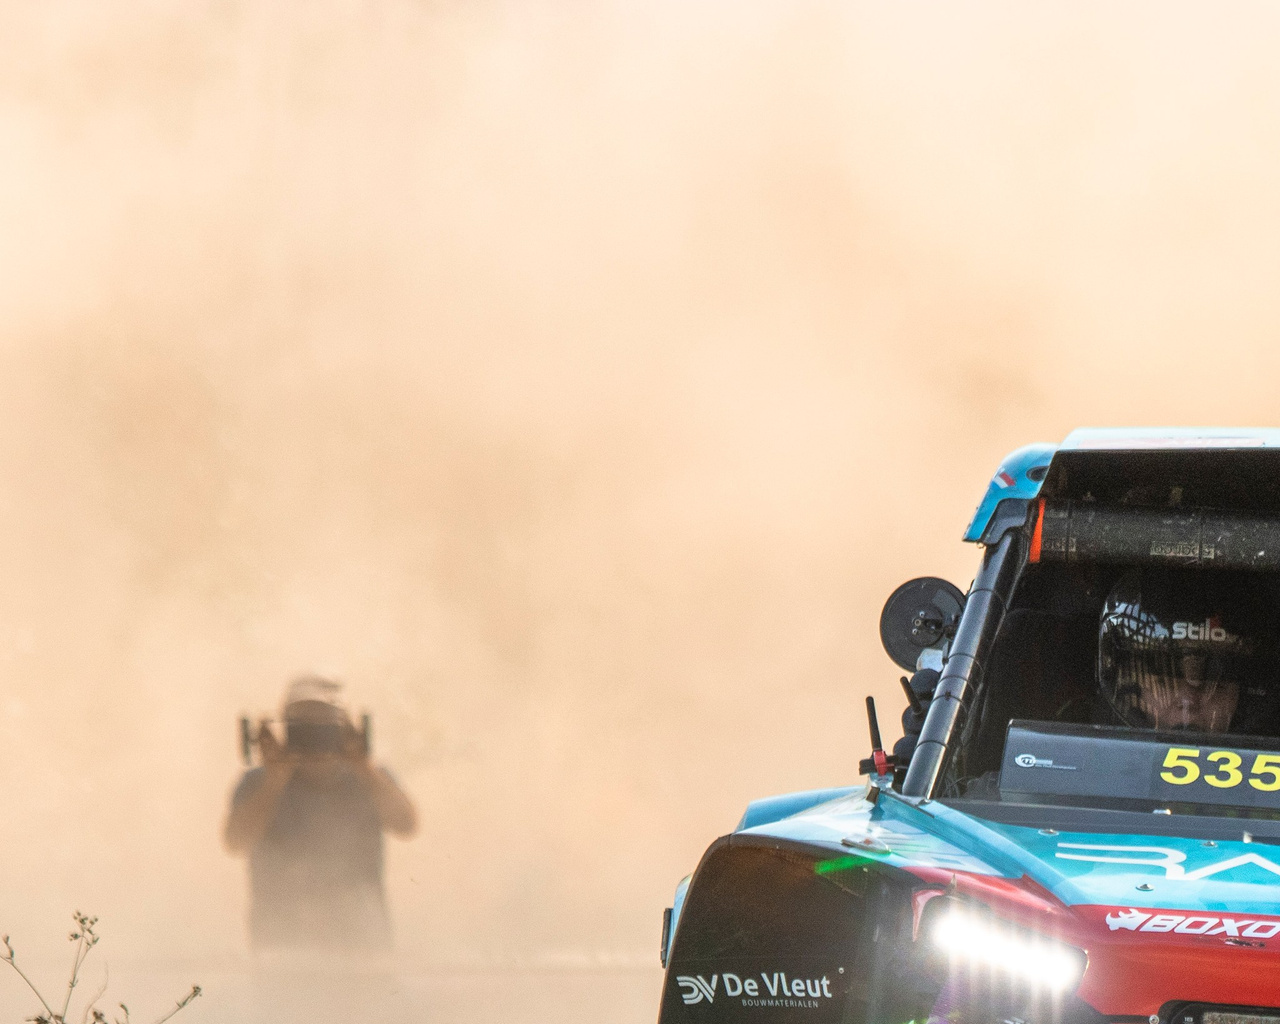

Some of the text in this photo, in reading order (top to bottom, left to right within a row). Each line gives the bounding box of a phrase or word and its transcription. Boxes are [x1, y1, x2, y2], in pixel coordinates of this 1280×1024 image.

[1172, 618, 1226, 641] Stilo
[722, 973, 759, 997] De
[761, 972, 833, 998] Vleut
[742, 999, 819, 1009] BOUWMATERIALEN
